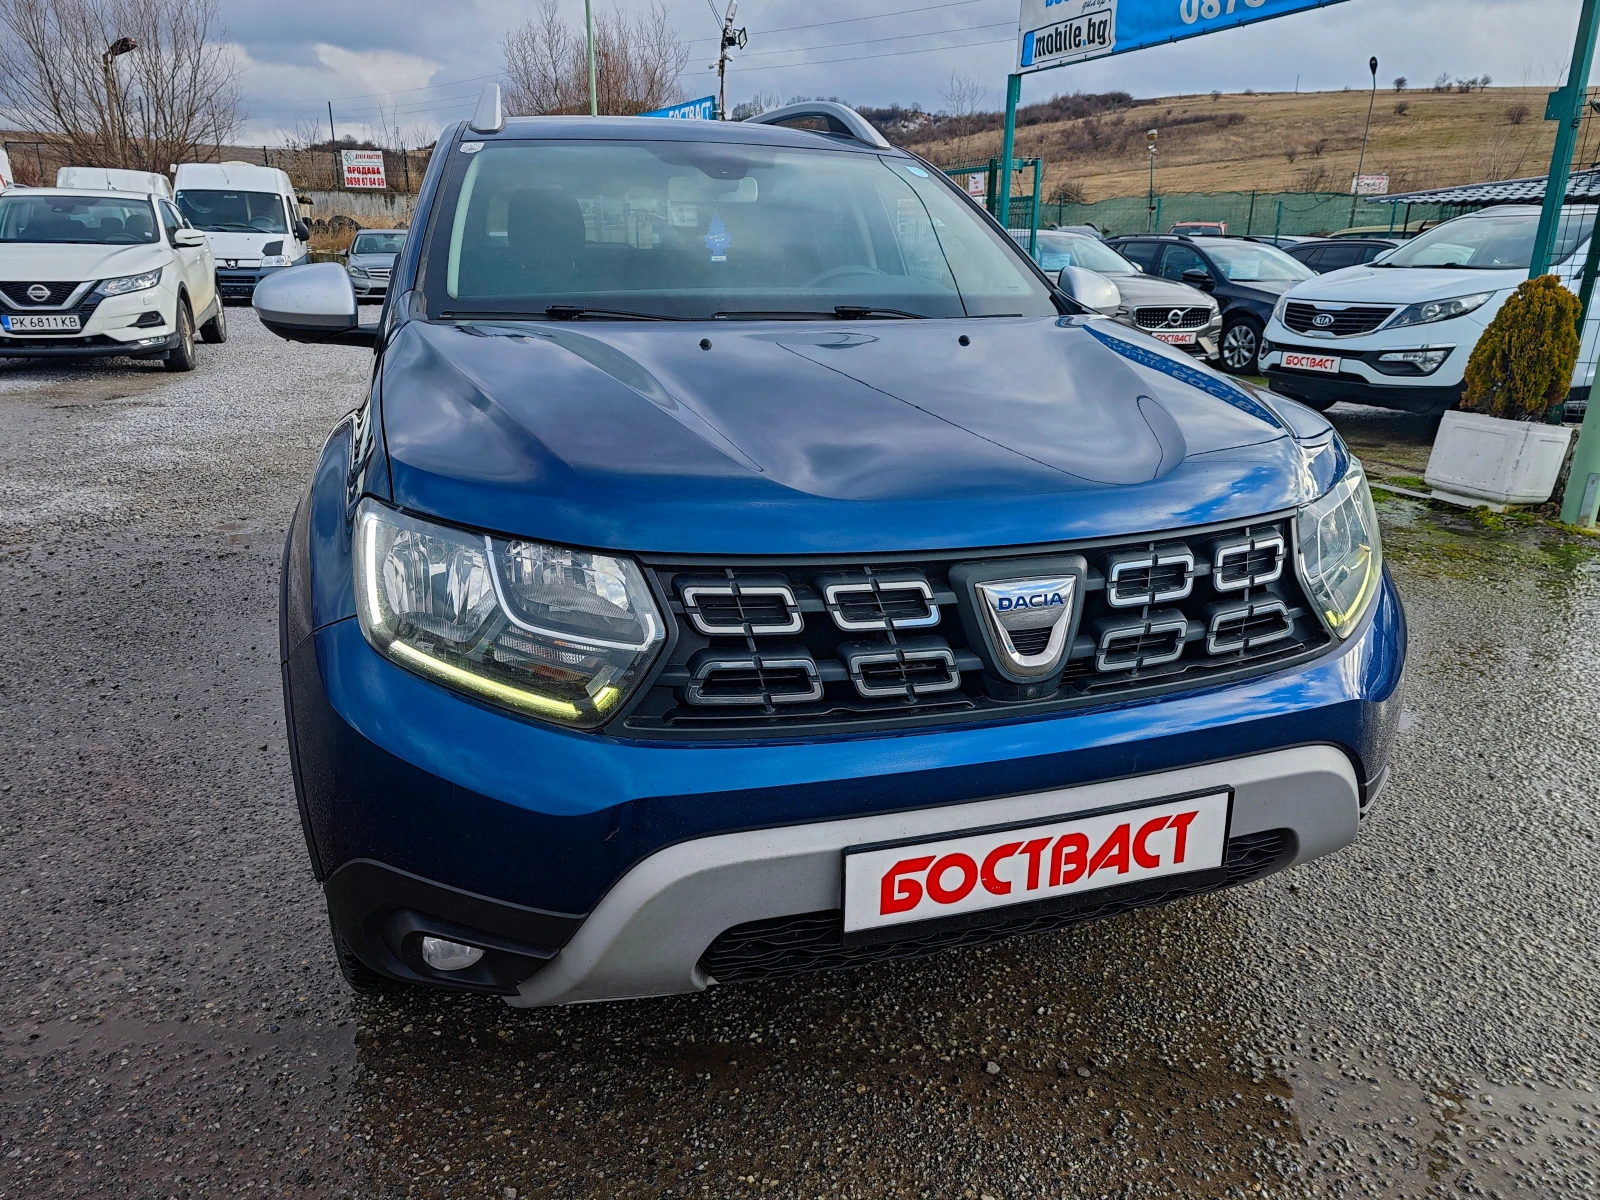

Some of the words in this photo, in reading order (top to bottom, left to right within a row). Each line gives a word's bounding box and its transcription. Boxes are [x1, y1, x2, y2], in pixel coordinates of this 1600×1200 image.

[1180, 0, 1265, 25] 08
[1034, 17, 1108, 58] mobile.bg
[347, 166, 382, 175] ПРОДАВА
[10, 317, 28, 328] PK
[30, 317, 59, 328] 6811
[60, 316, 78, 328] KB
[1315, 316, 1330, 325] KIA
[1285, 355, 1336, 370] БОСТВАСТ
[998, 592, 1064, 611] DACIA
[879, 810, 1199, 915] БОСТВАСТ
